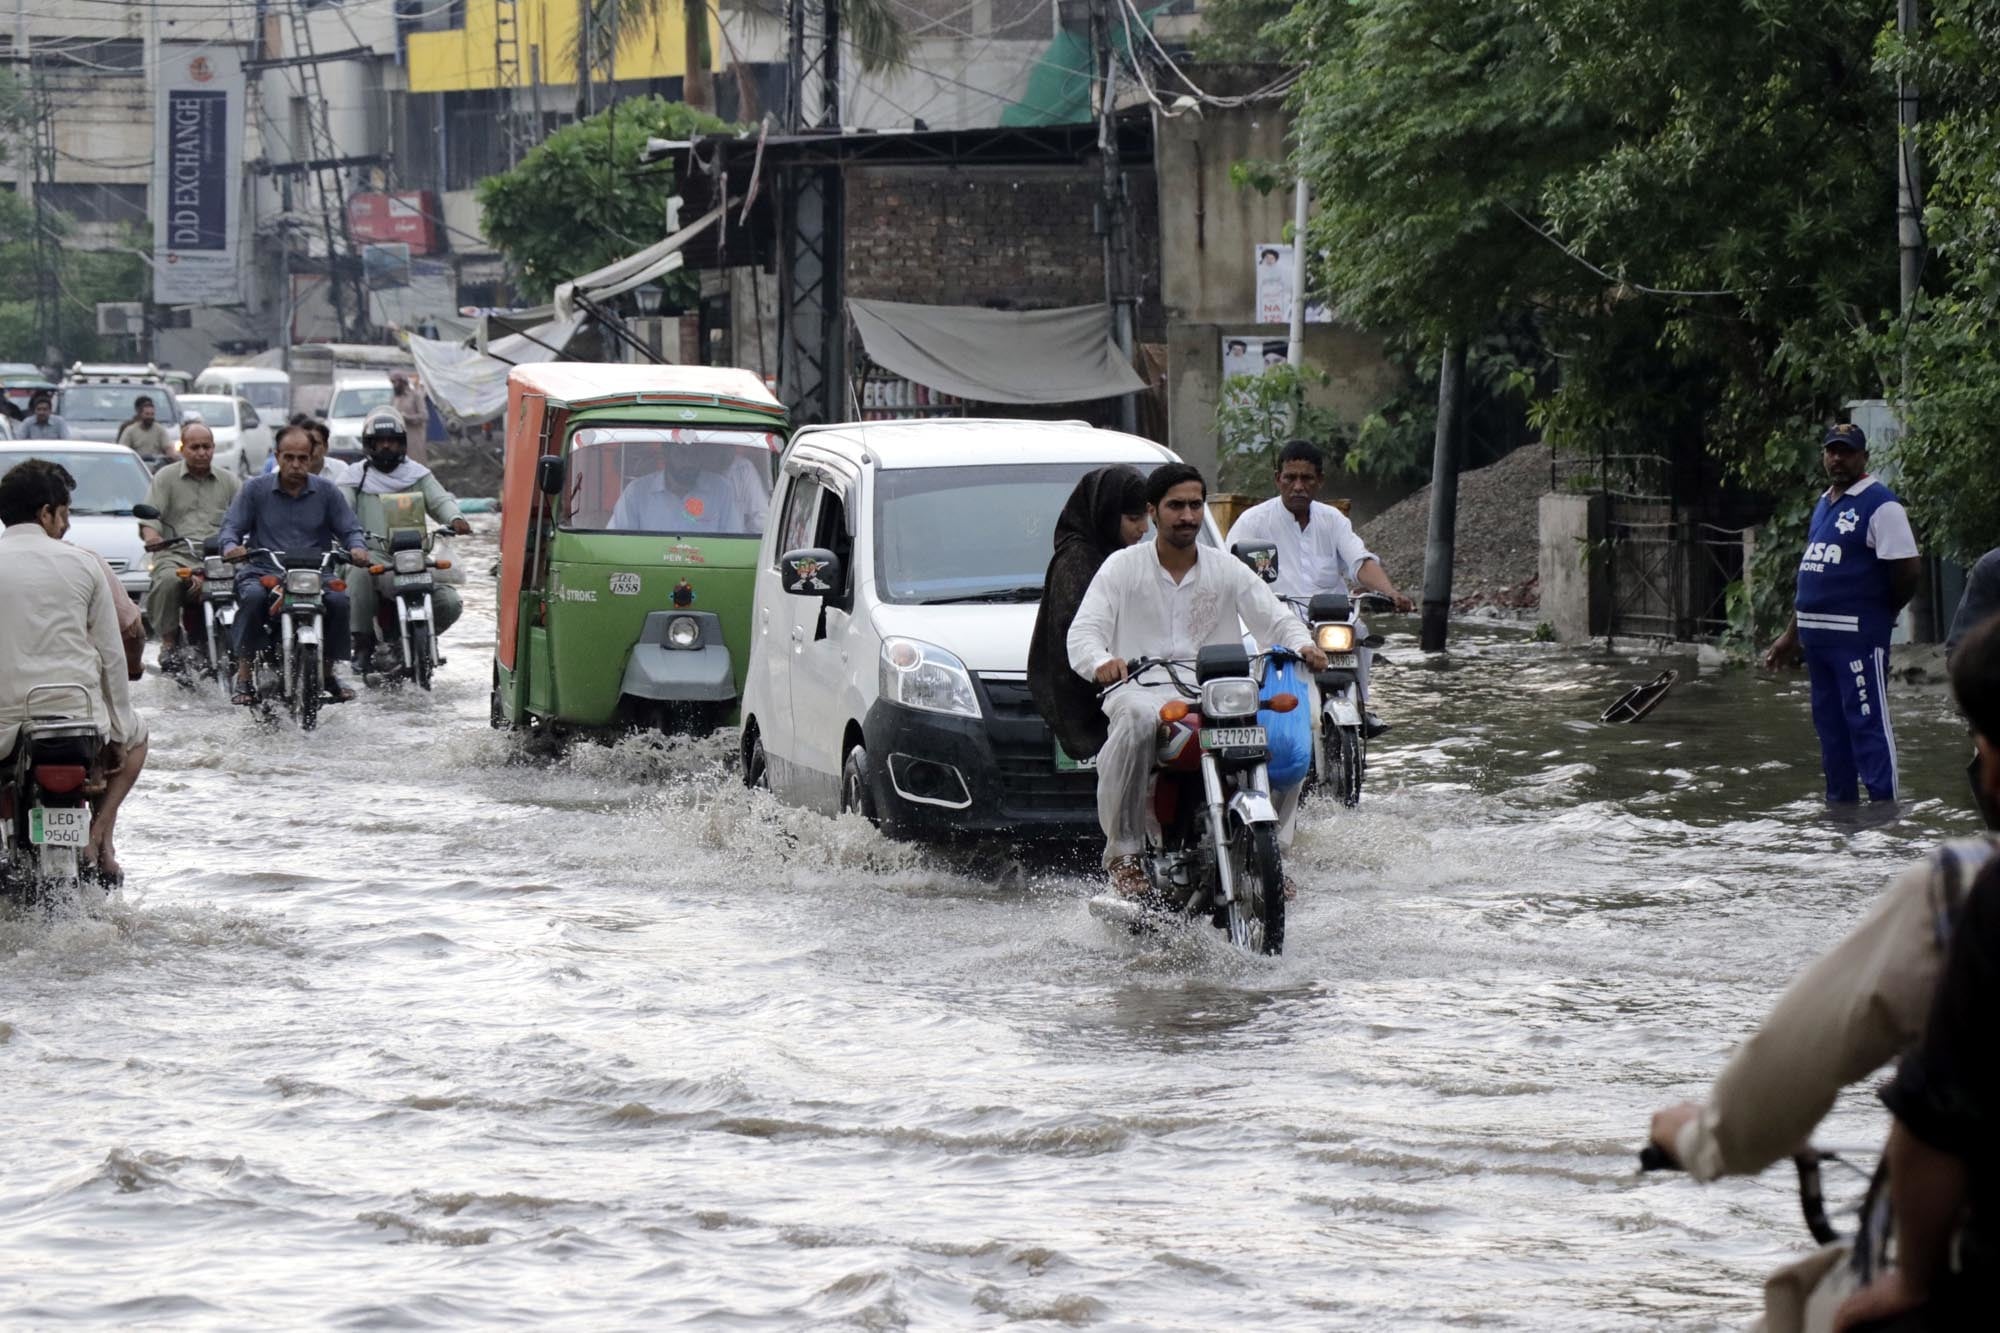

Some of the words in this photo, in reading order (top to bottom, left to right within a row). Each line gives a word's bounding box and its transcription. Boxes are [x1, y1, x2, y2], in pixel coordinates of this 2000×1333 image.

[174, 99, 200, 206] EXCHANGE
[1263, 303, 1281, 312] NA
[612, 583, 639, 593] 1858
[566, 589, 598, 602] STROKE
[1849, 658, 1871, 716] WASA
[1211, 728, 1257, 746] LEZ7297
[44, 829, 80, 842] 9560
